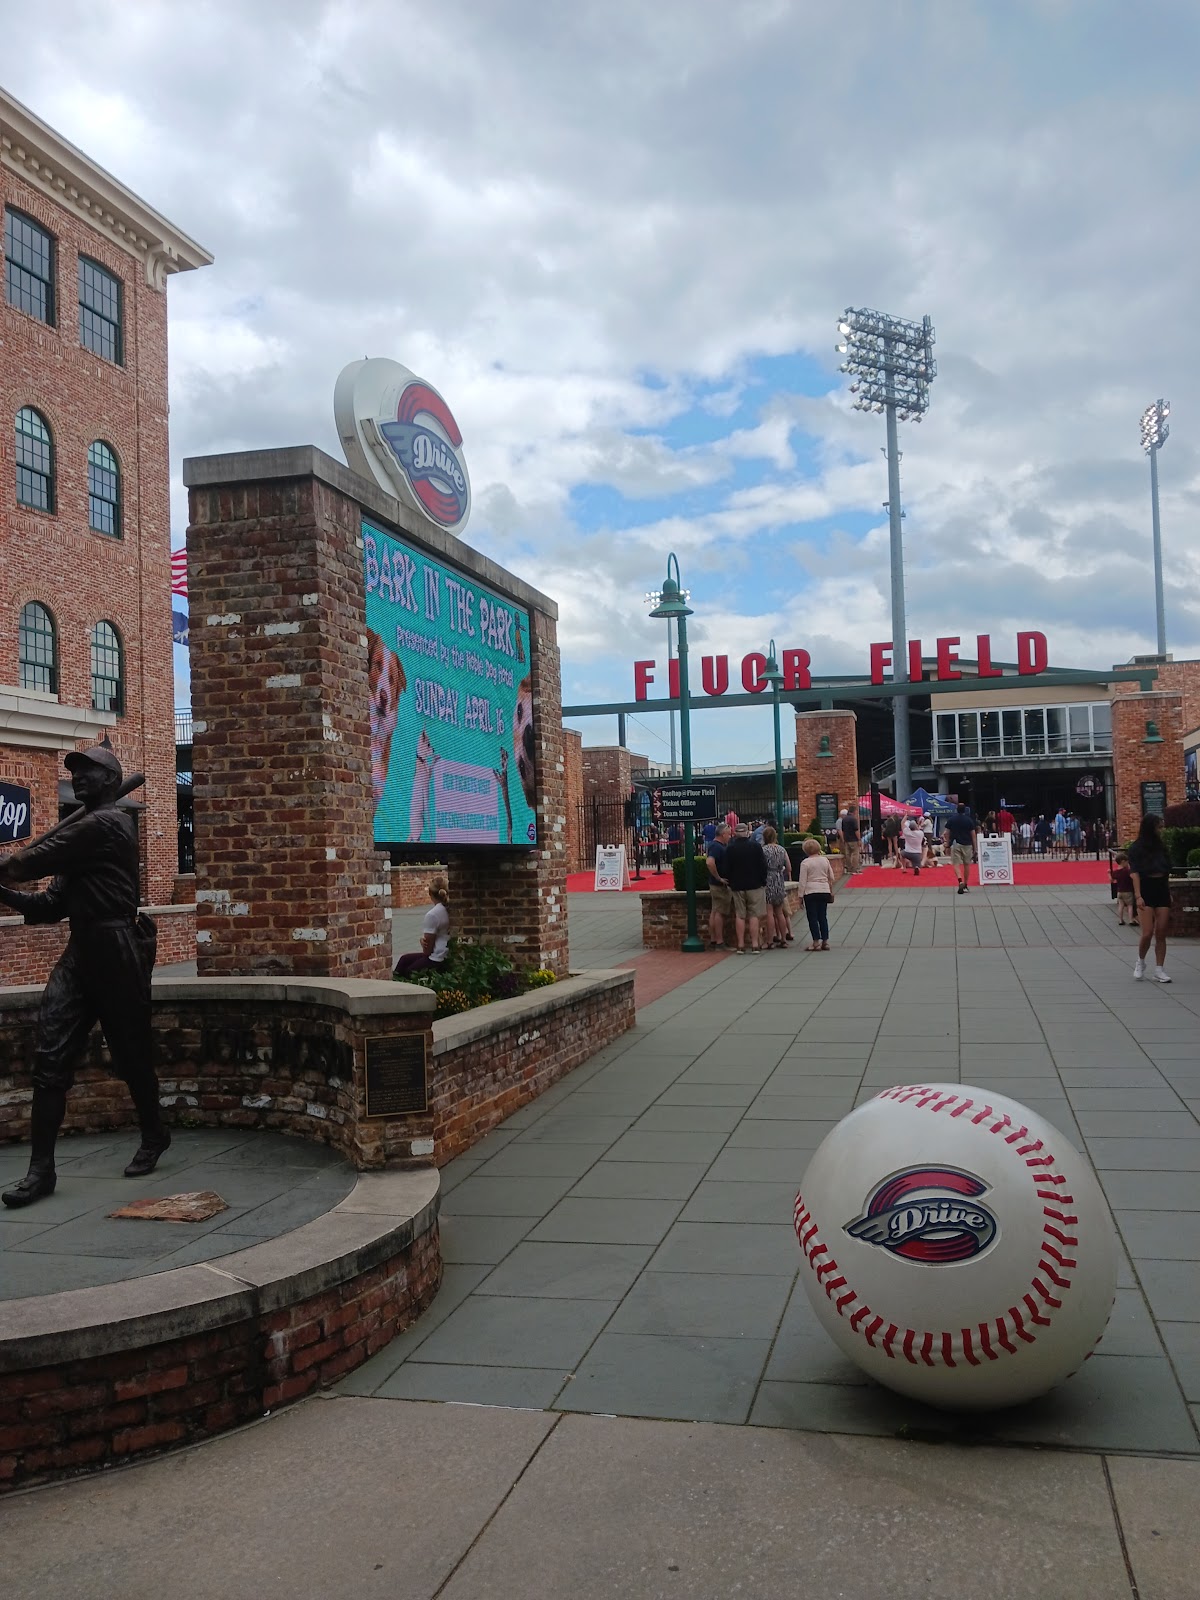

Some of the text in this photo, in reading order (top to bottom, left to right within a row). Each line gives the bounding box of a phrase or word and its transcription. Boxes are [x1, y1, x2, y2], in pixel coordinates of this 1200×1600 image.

[413, 434, 464, 492] Drive
[363, 532, 515, 657] BARK IN THE PARK
[440, 636, 450, 669] by
[451, 643, 465, 669] the
[869, 630, 1049, 687] FIELD
[464, 693, 494, 733] APRIL
[495, 707, 505, 736] 16
[662, 799, 697, 807] Ticket Office
[662, 809, 694, 818] Team Store
[889, 1201, 986, 1240] Drive
